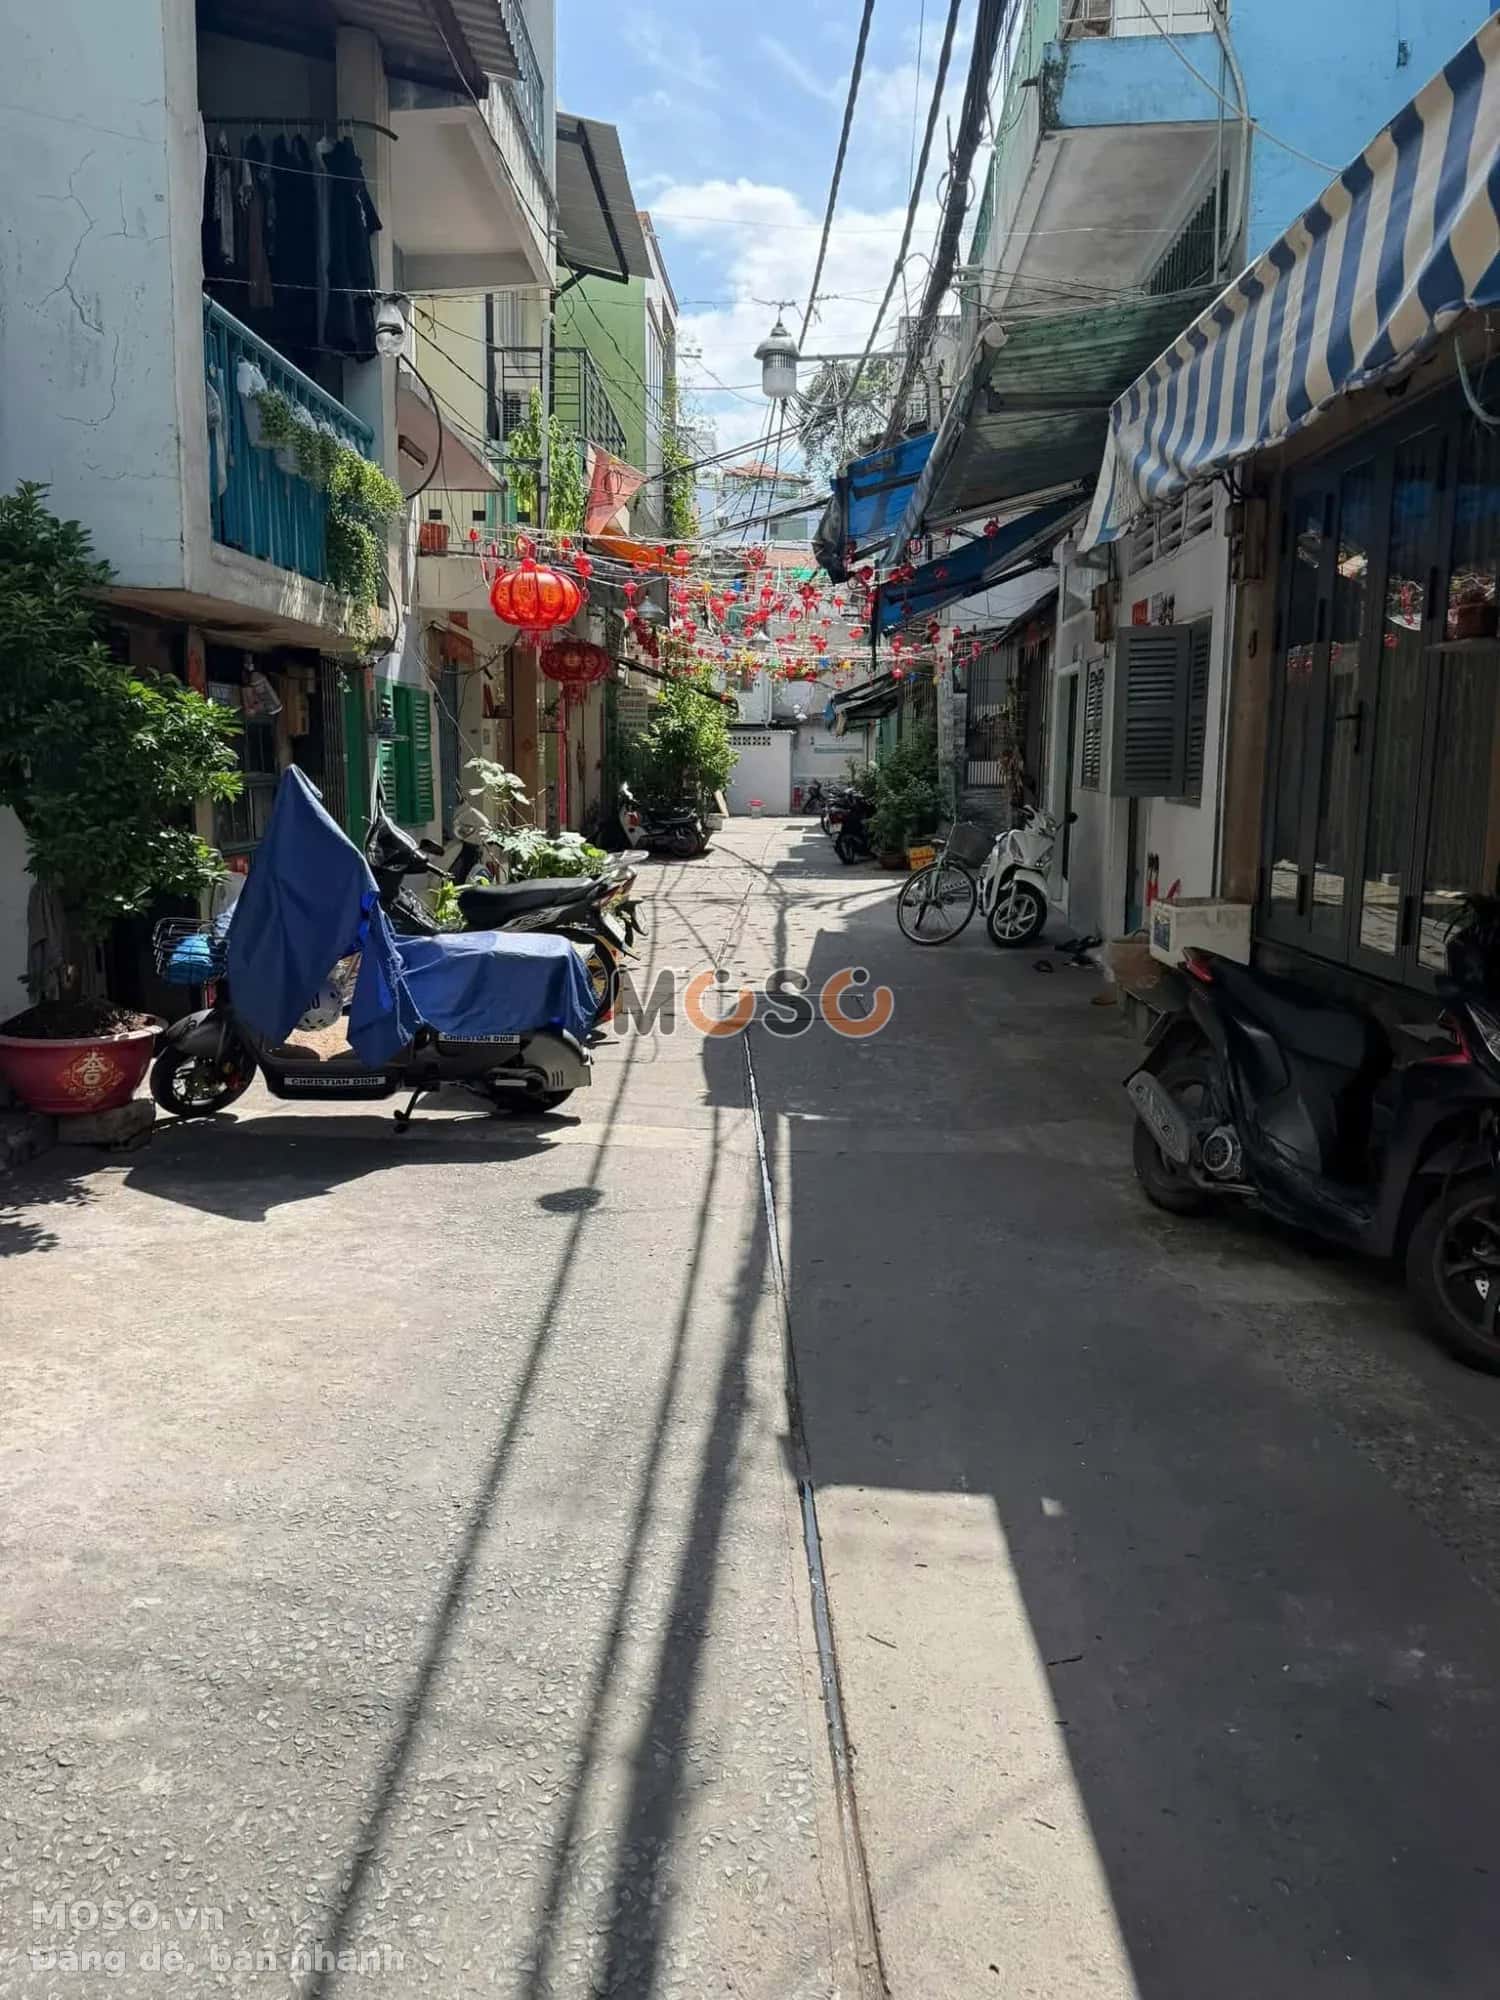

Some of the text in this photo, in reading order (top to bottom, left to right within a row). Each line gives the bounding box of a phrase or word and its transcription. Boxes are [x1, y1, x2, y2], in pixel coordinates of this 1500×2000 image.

[493, 1034, 515, 1043] DIOR
[291, 1077, 379, 1087] CHRISTIAN DIOR
